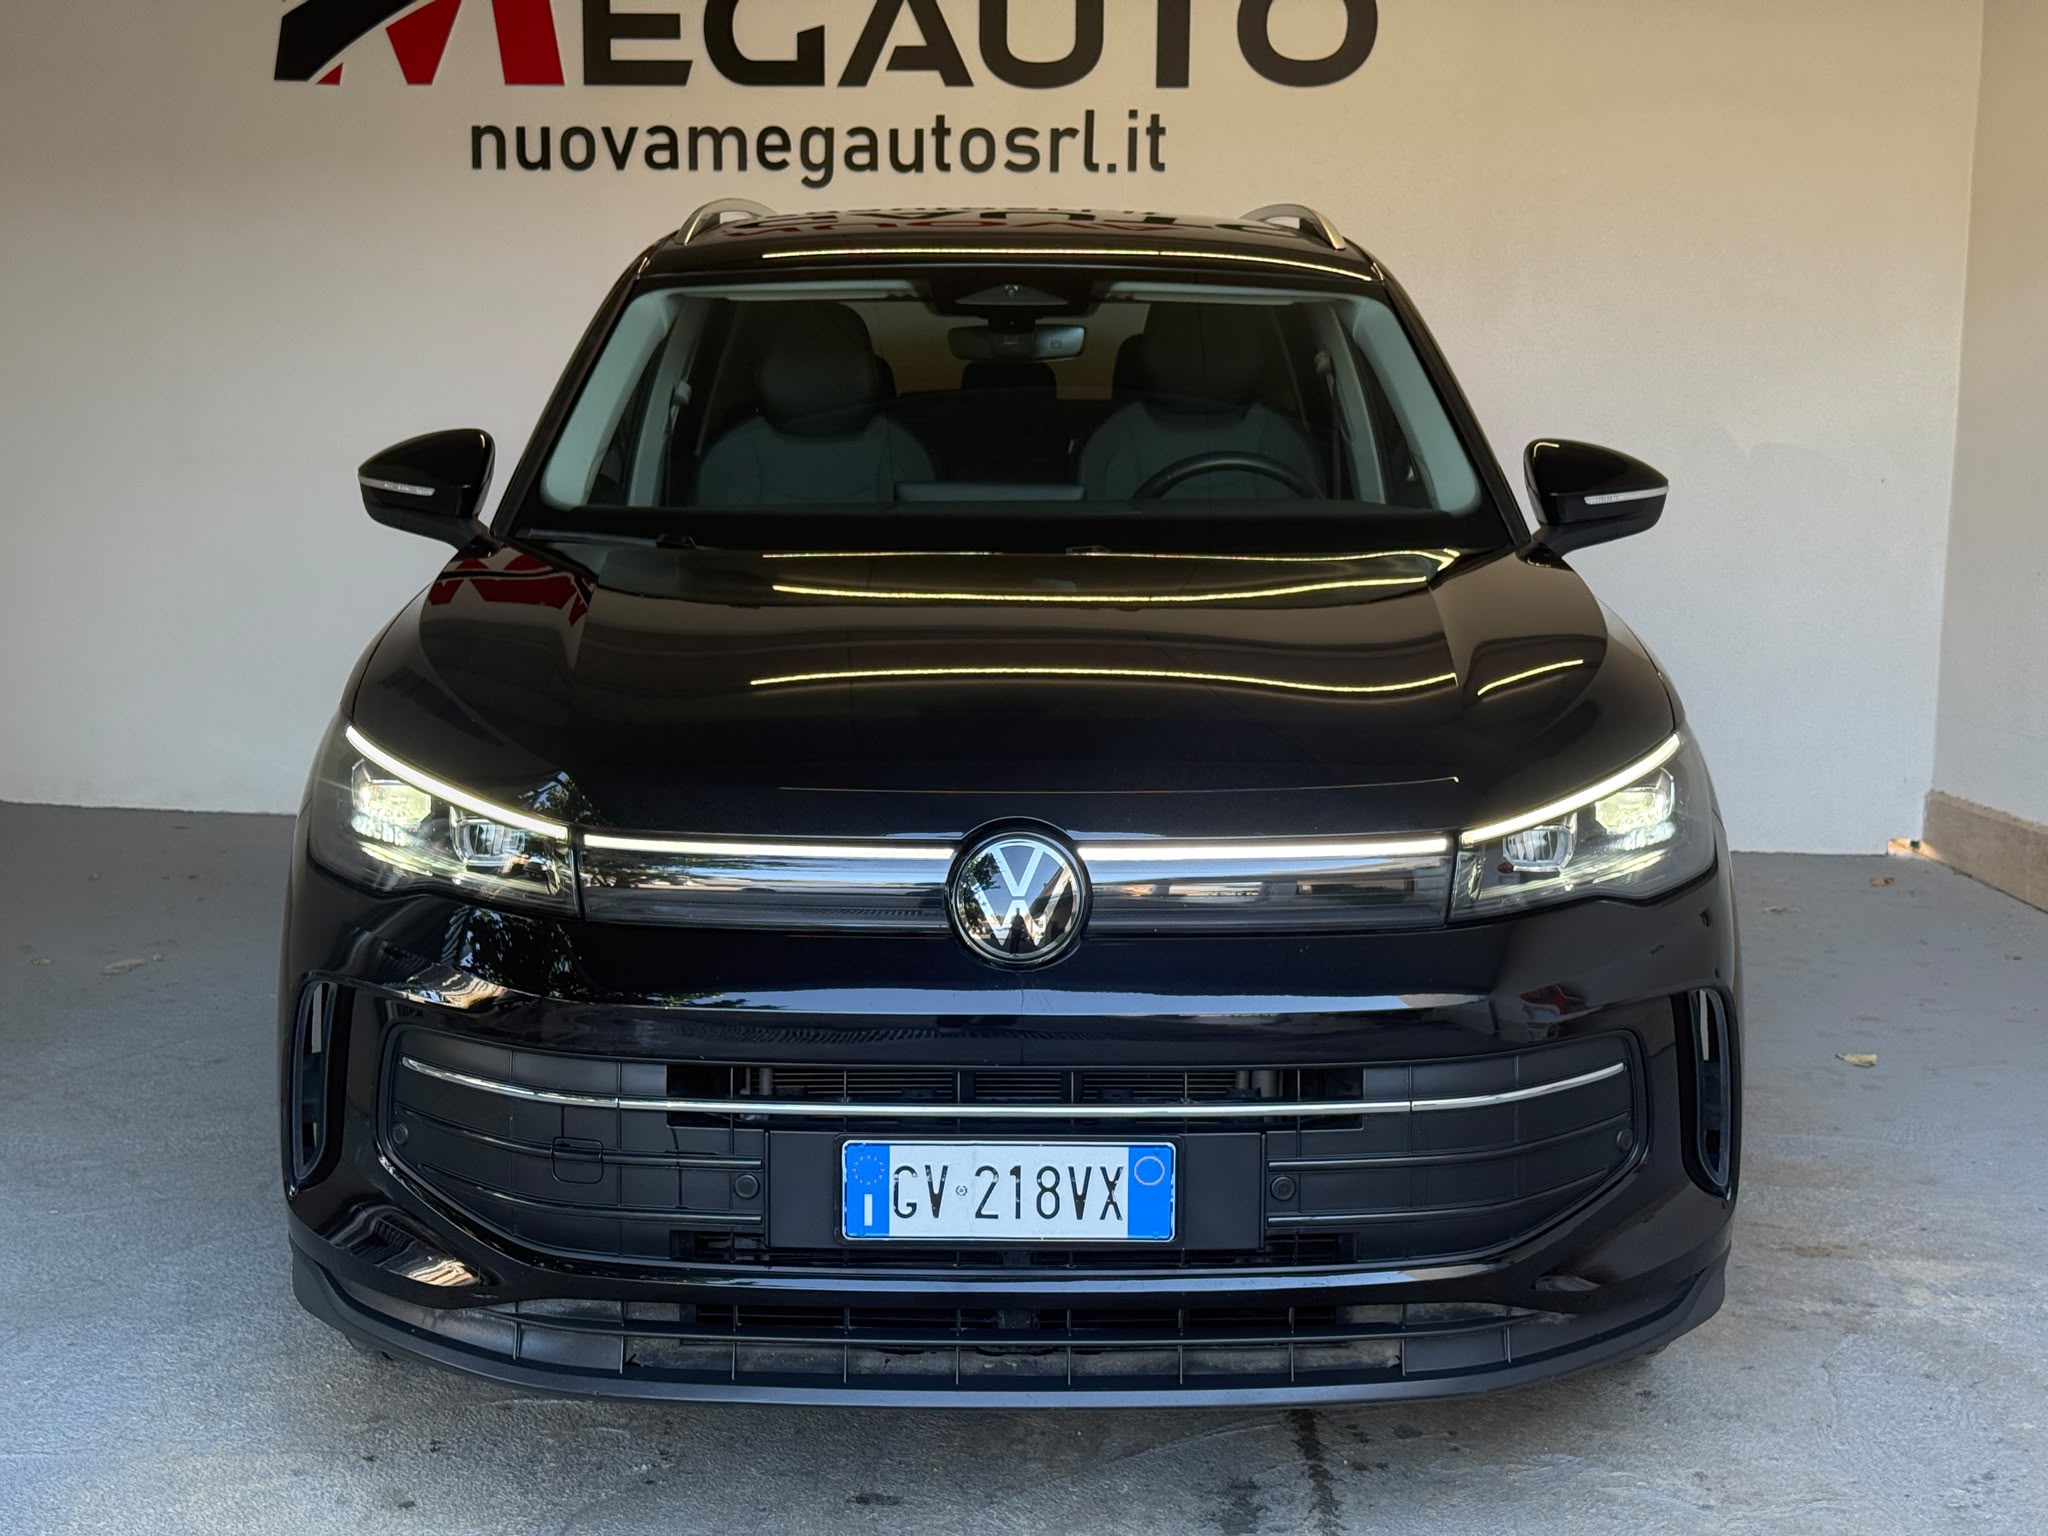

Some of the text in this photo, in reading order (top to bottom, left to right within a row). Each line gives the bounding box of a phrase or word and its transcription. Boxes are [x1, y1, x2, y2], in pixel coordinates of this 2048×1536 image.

[471, 109, 1166, 189] nuovamegautosrl.it
[893, 1164, 1124, 1221] GV 218VX
